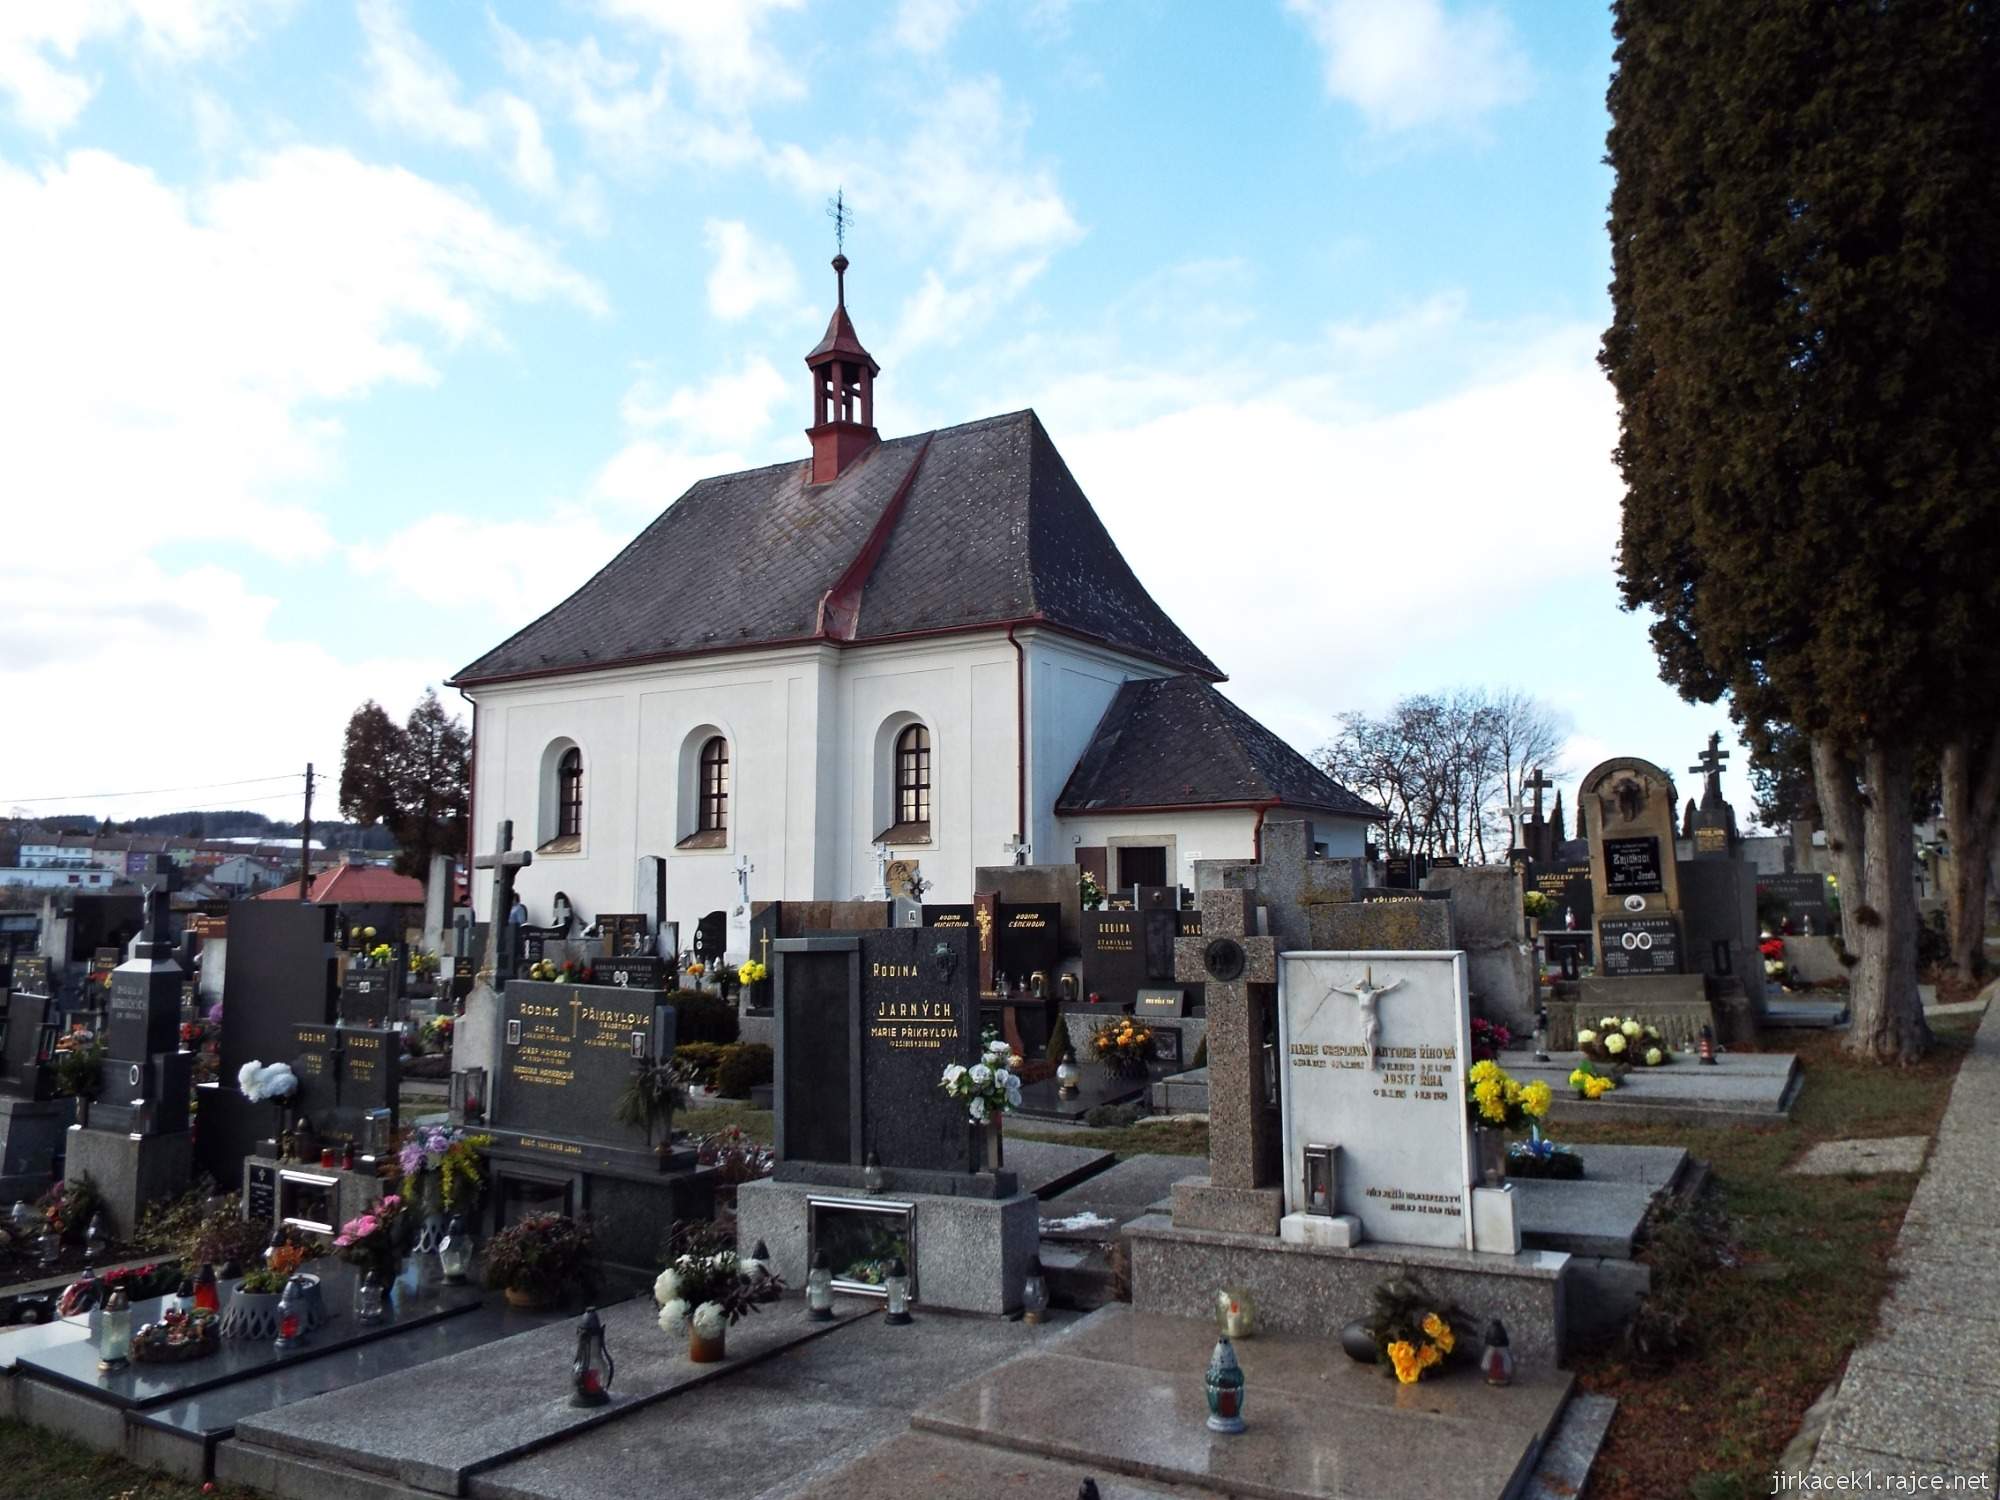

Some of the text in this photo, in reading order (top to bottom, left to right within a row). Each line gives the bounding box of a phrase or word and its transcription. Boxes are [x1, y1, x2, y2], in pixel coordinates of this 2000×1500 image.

[873, 963, 918, 977] RODINA
[520, 1002, 559, 1017] RODINA
[878, 999, 951, 1017] JARNÝCH
[871, 1024, 958, 1038] MARIE PŘIKRYLOVÁ
[1384, 1073, 1416, 1086] JOSEF
